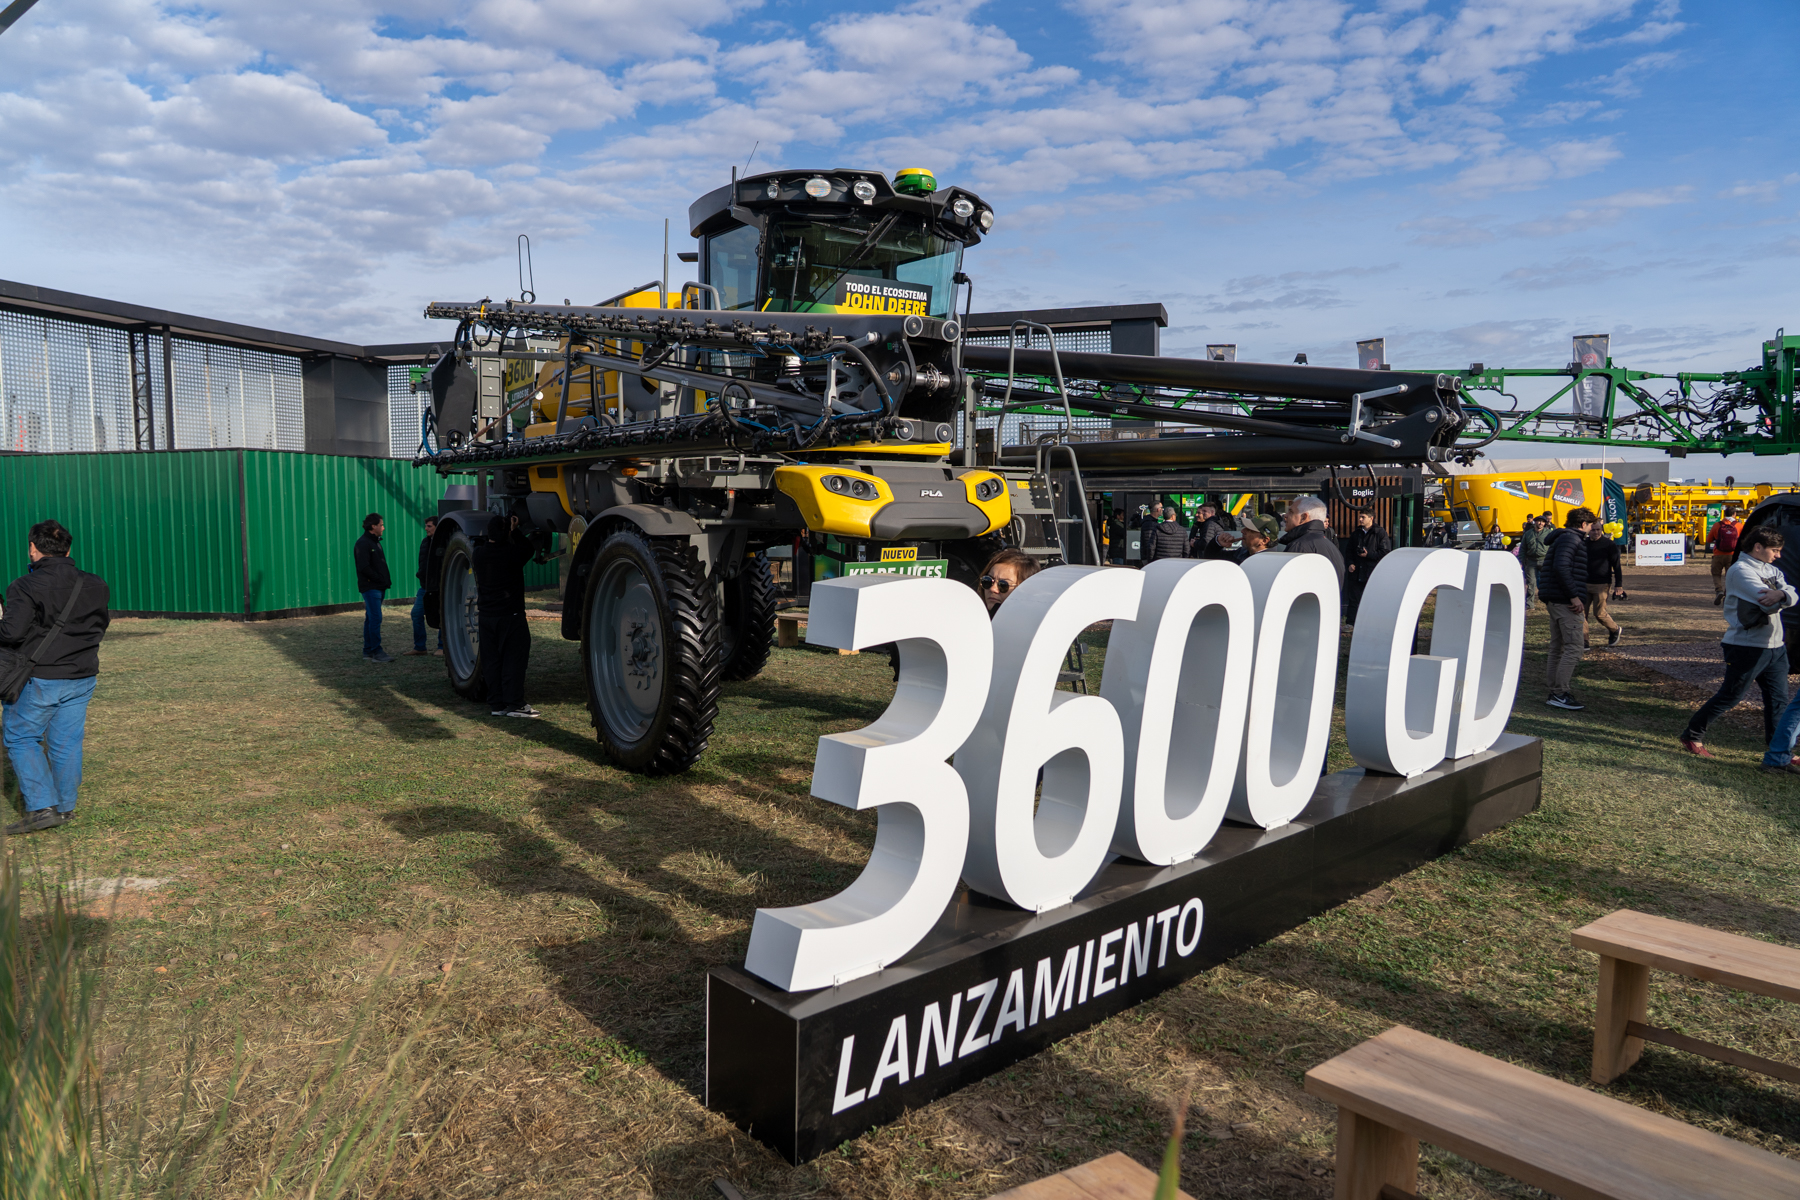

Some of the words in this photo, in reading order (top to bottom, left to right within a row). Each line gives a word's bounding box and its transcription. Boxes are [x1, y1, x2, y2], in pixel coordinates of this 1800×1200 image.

[846, 282, 870, 293] TODO
[872, 285, 881, 295] EL
[883, 287, 927, 301] ECOSISTEMA
[842, 292, 885, 311] JOHN
[887, 297, 927, 316] DEERE
[920, 489, 944, 498] PLA
[1352, 489, 1374, 497] Boglic
[1553, 494, 1581, 506] ASCANELLI
[882, 549, 915, 560] NUEVO
[899, 565, 943, 579] LUCES
[747, 550, 1342, 992] 3600
[1347, 547, 1525, 777] GD
[832, 897, 1205, 1114] LANZAMIENTO
